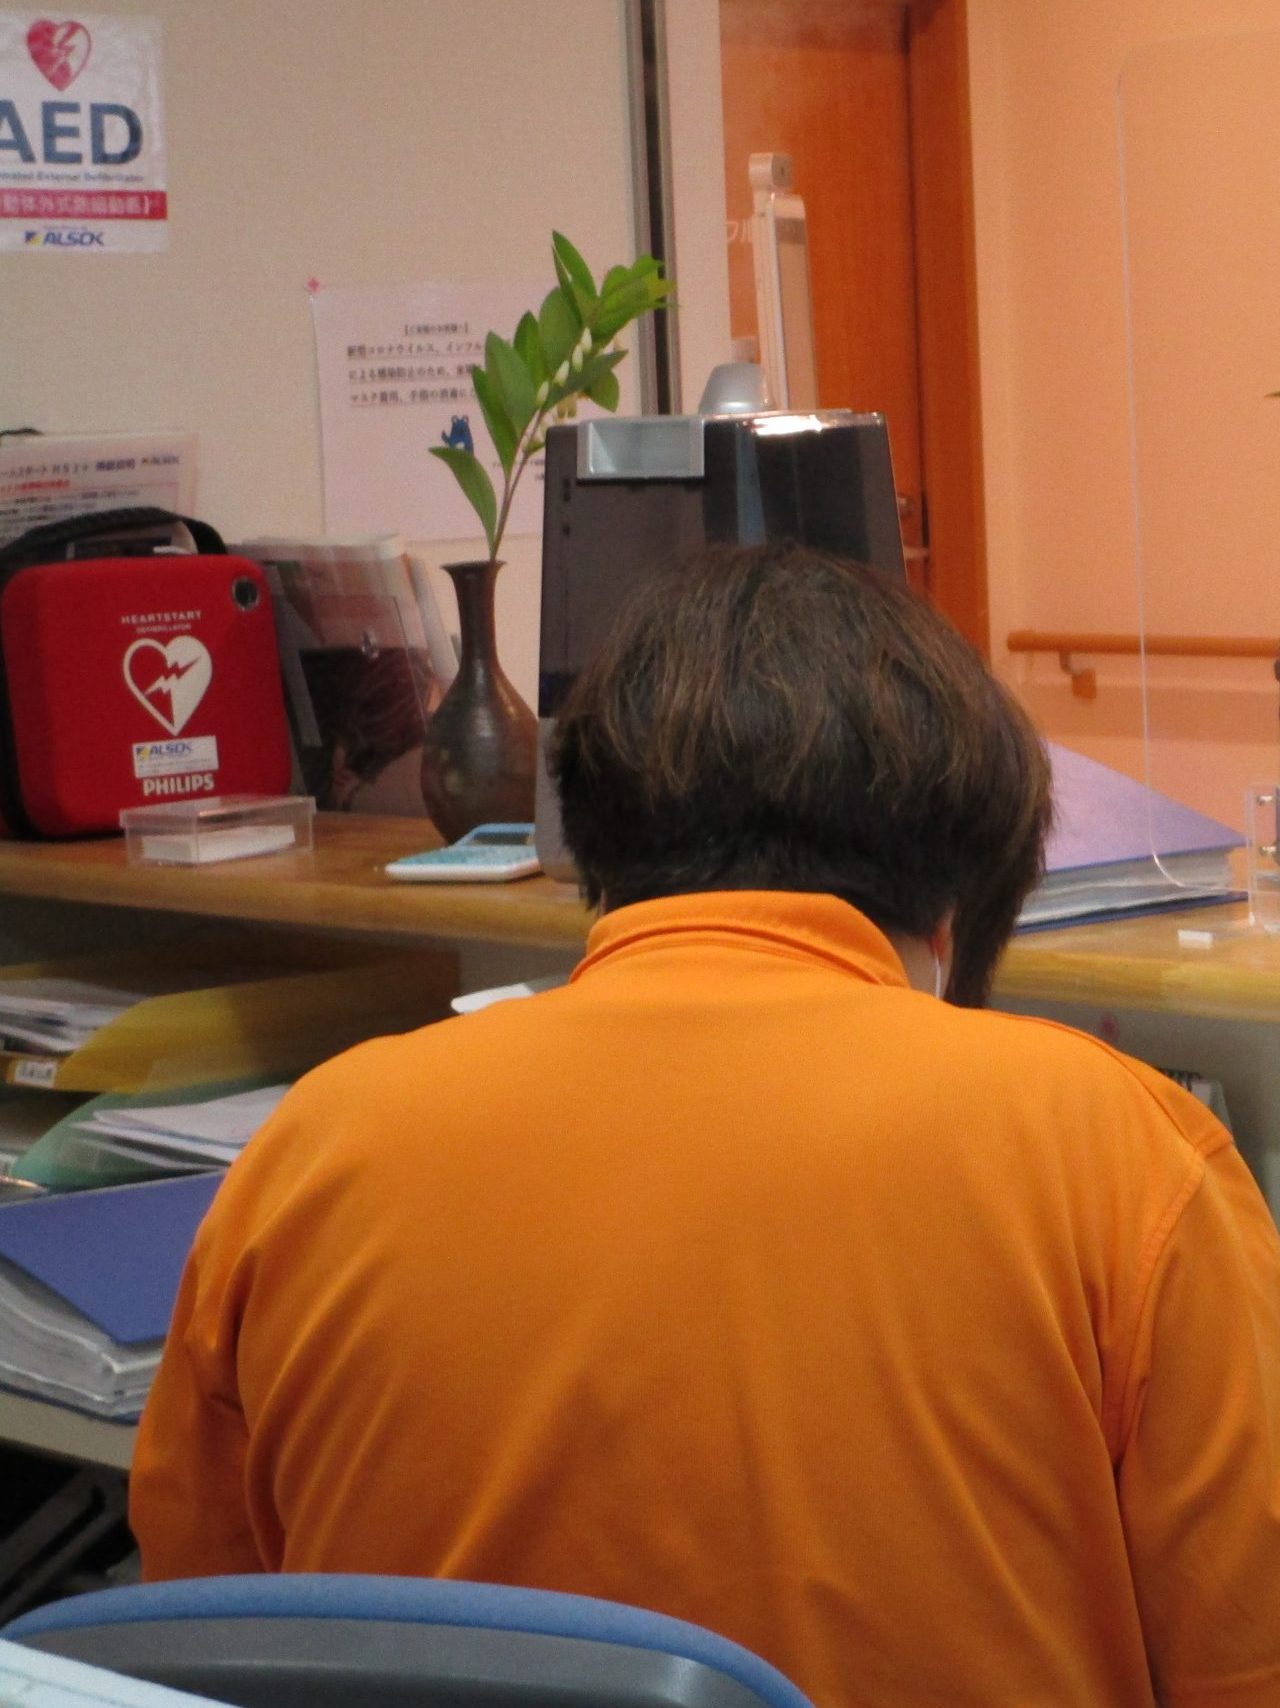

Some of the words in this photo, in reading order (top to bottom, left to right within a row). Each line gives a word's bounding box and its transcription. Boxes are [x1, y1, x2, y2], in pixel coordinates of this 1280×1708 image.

[0, 99, 143, 165] AED
[43, 231, 104, 246] ALSOK
[121, 610, 202, 624] HEARTSTART
[150, 742, 193, 755] ALSOK
[143, 774, 215, 796] PHILIPS
